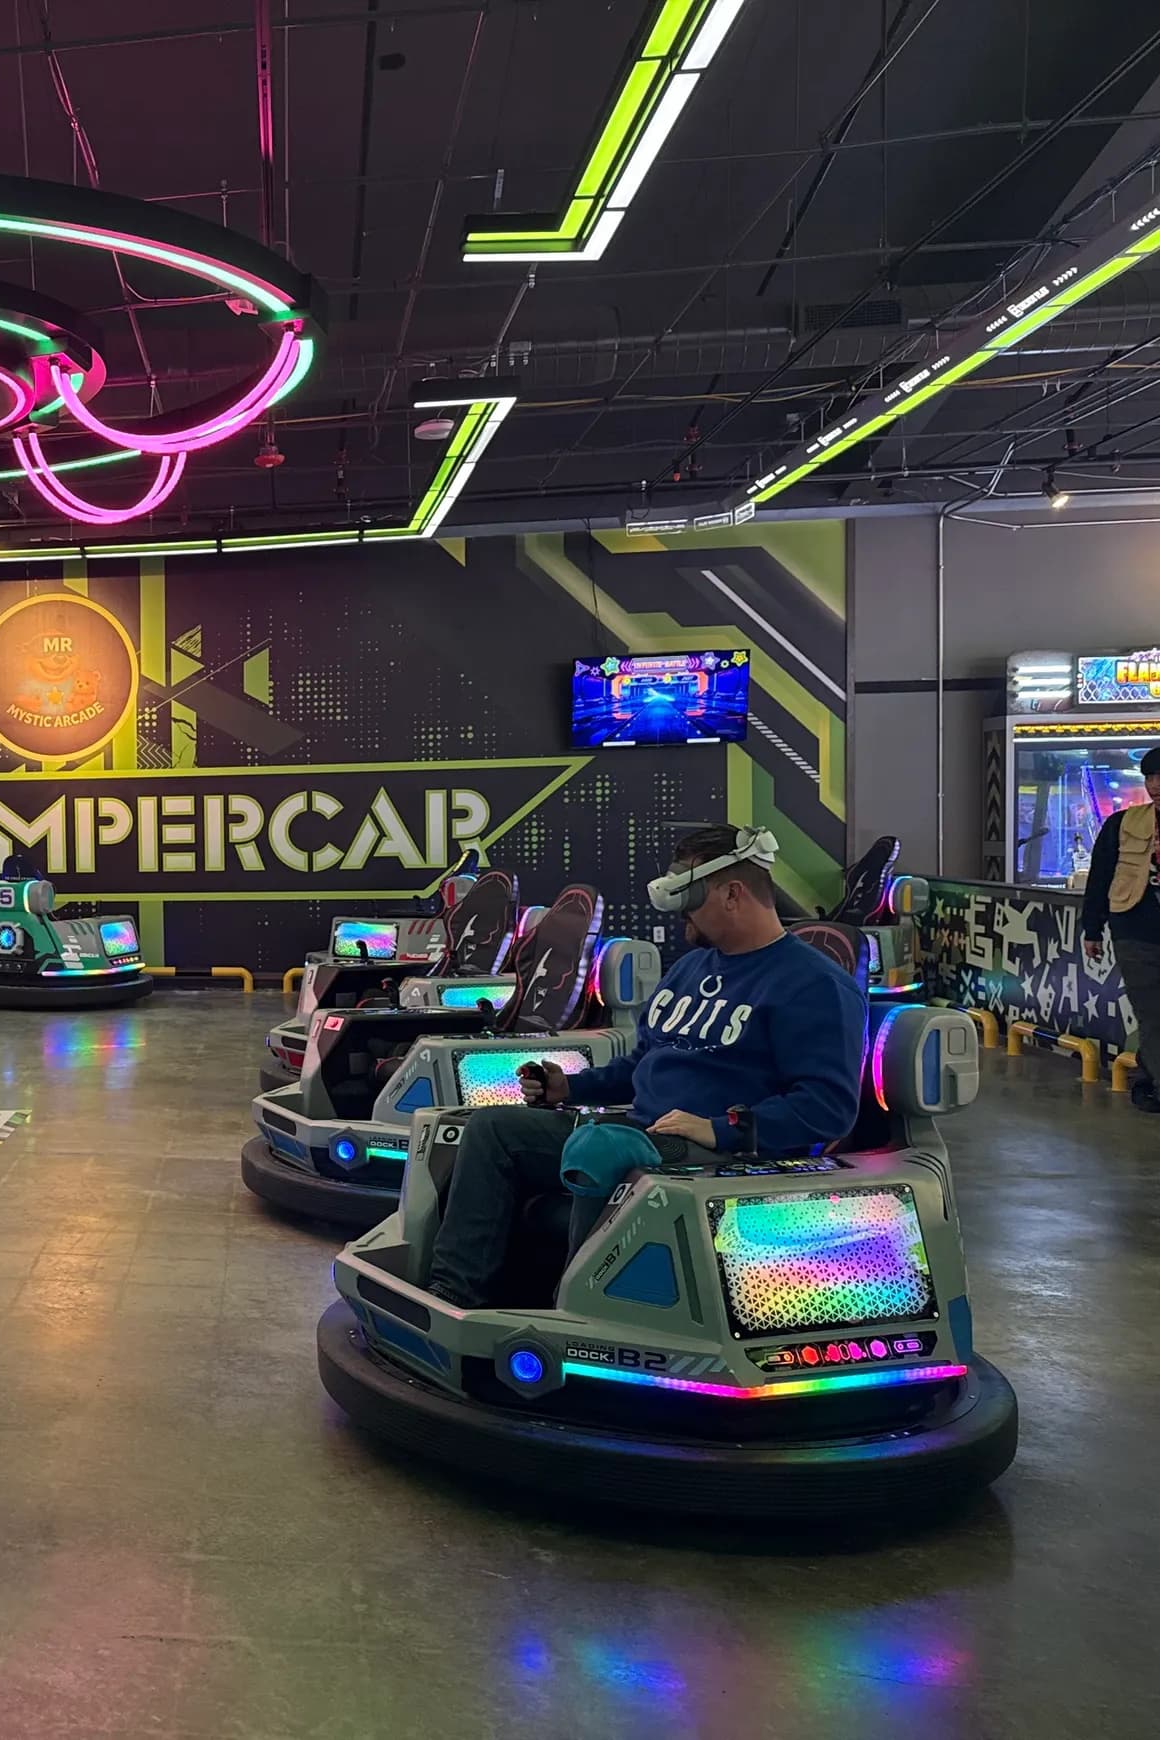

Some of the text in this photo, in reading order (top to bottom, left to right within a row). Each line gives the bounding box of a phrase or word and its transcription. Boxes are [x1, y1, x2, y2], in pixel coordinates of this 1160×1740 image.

[43, 637, 73, 653] MR
[6, 701, 105, 727] MYSTIC ARCADE
[0, 889, 12, 905] 5
[648, 988, 752, 1046] COLTS
[567, 1341, 615, 1352] LOADING
[567, 1347, 667, 1372] DOCK. B2
